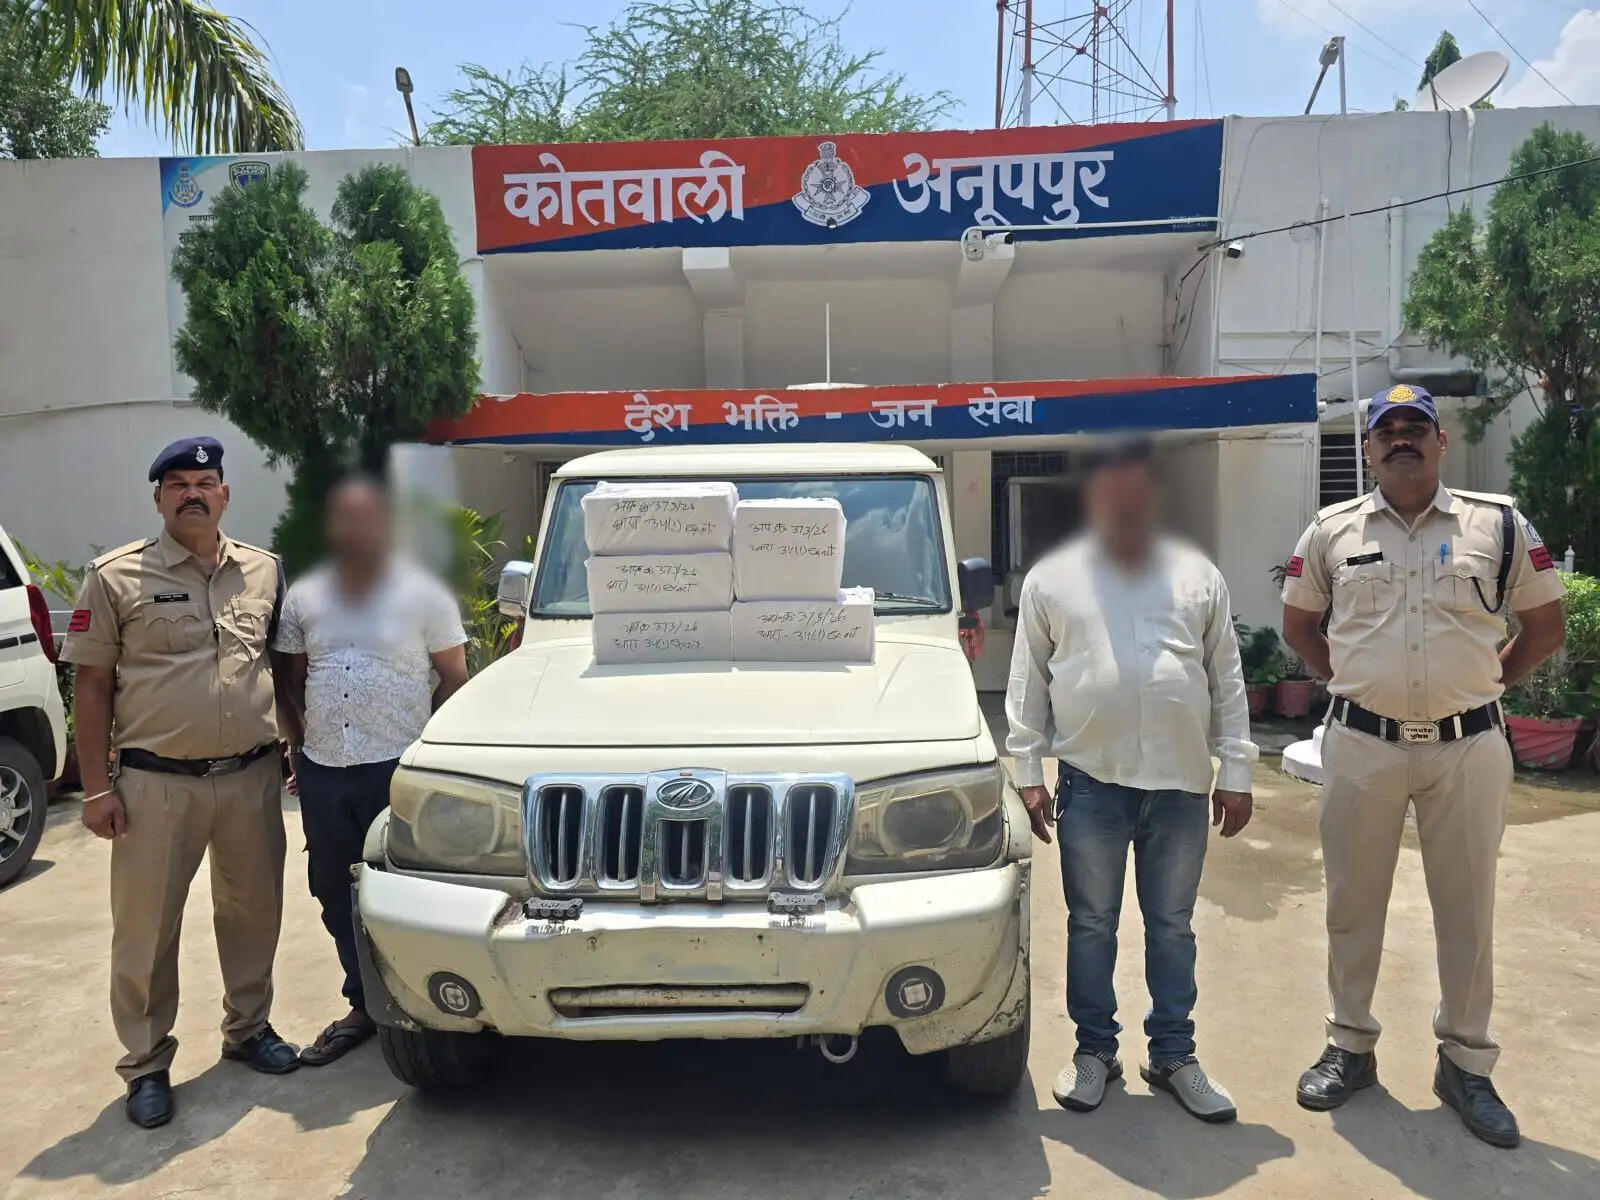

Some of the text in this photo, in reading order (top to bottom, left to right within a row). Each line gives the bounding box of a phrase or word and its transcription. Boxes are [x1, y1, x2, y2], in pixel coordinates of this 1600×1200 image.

[503, 150, 1114, 227] कोतवाली अनूपपुर
[624, 392, 693, 442] देश
[721, 394, 799, 433] भक्ति
[868, 399, 938, 429] जन
[967, 386, 1036, 428] सेवा
